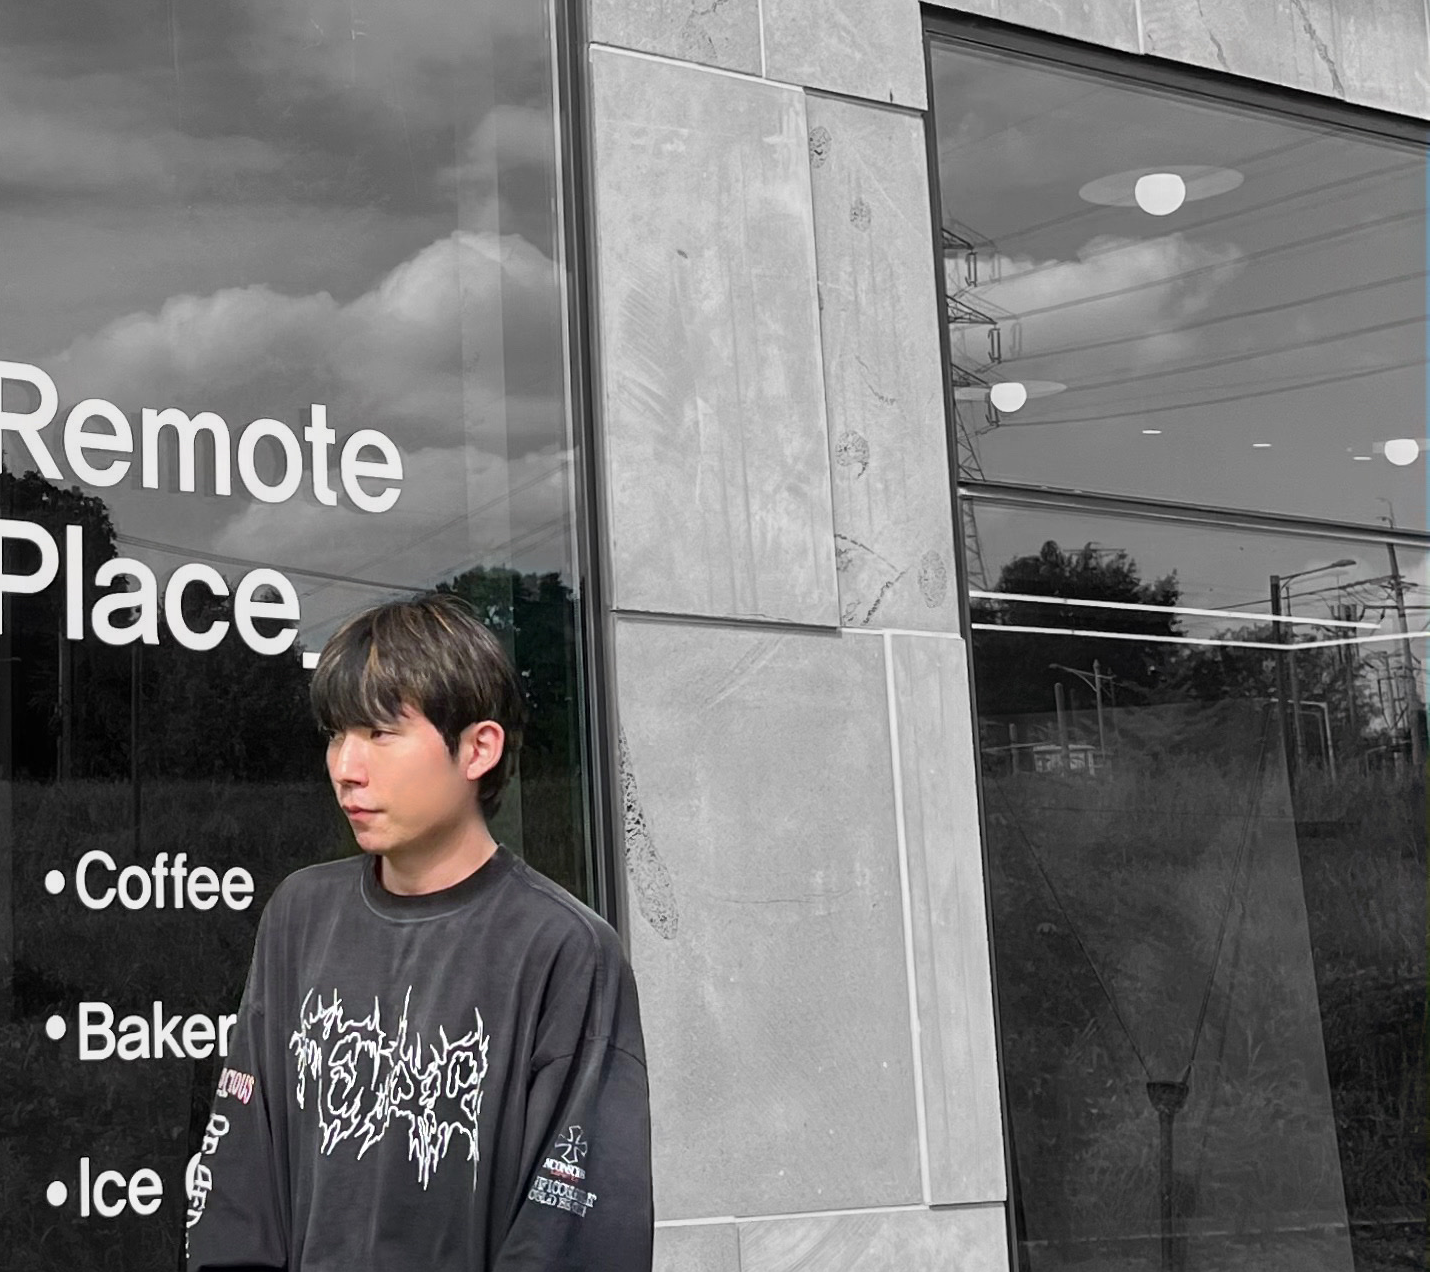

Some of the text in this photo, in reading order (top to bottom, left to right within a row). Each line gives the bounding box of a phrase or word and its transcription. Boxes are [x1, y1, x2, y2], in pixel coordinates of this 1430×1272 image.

[75, 849, 255, 911] Coffee
[78, 1000, 238, 1061] Baker
[80, 1156, 164, 1218] Ice
